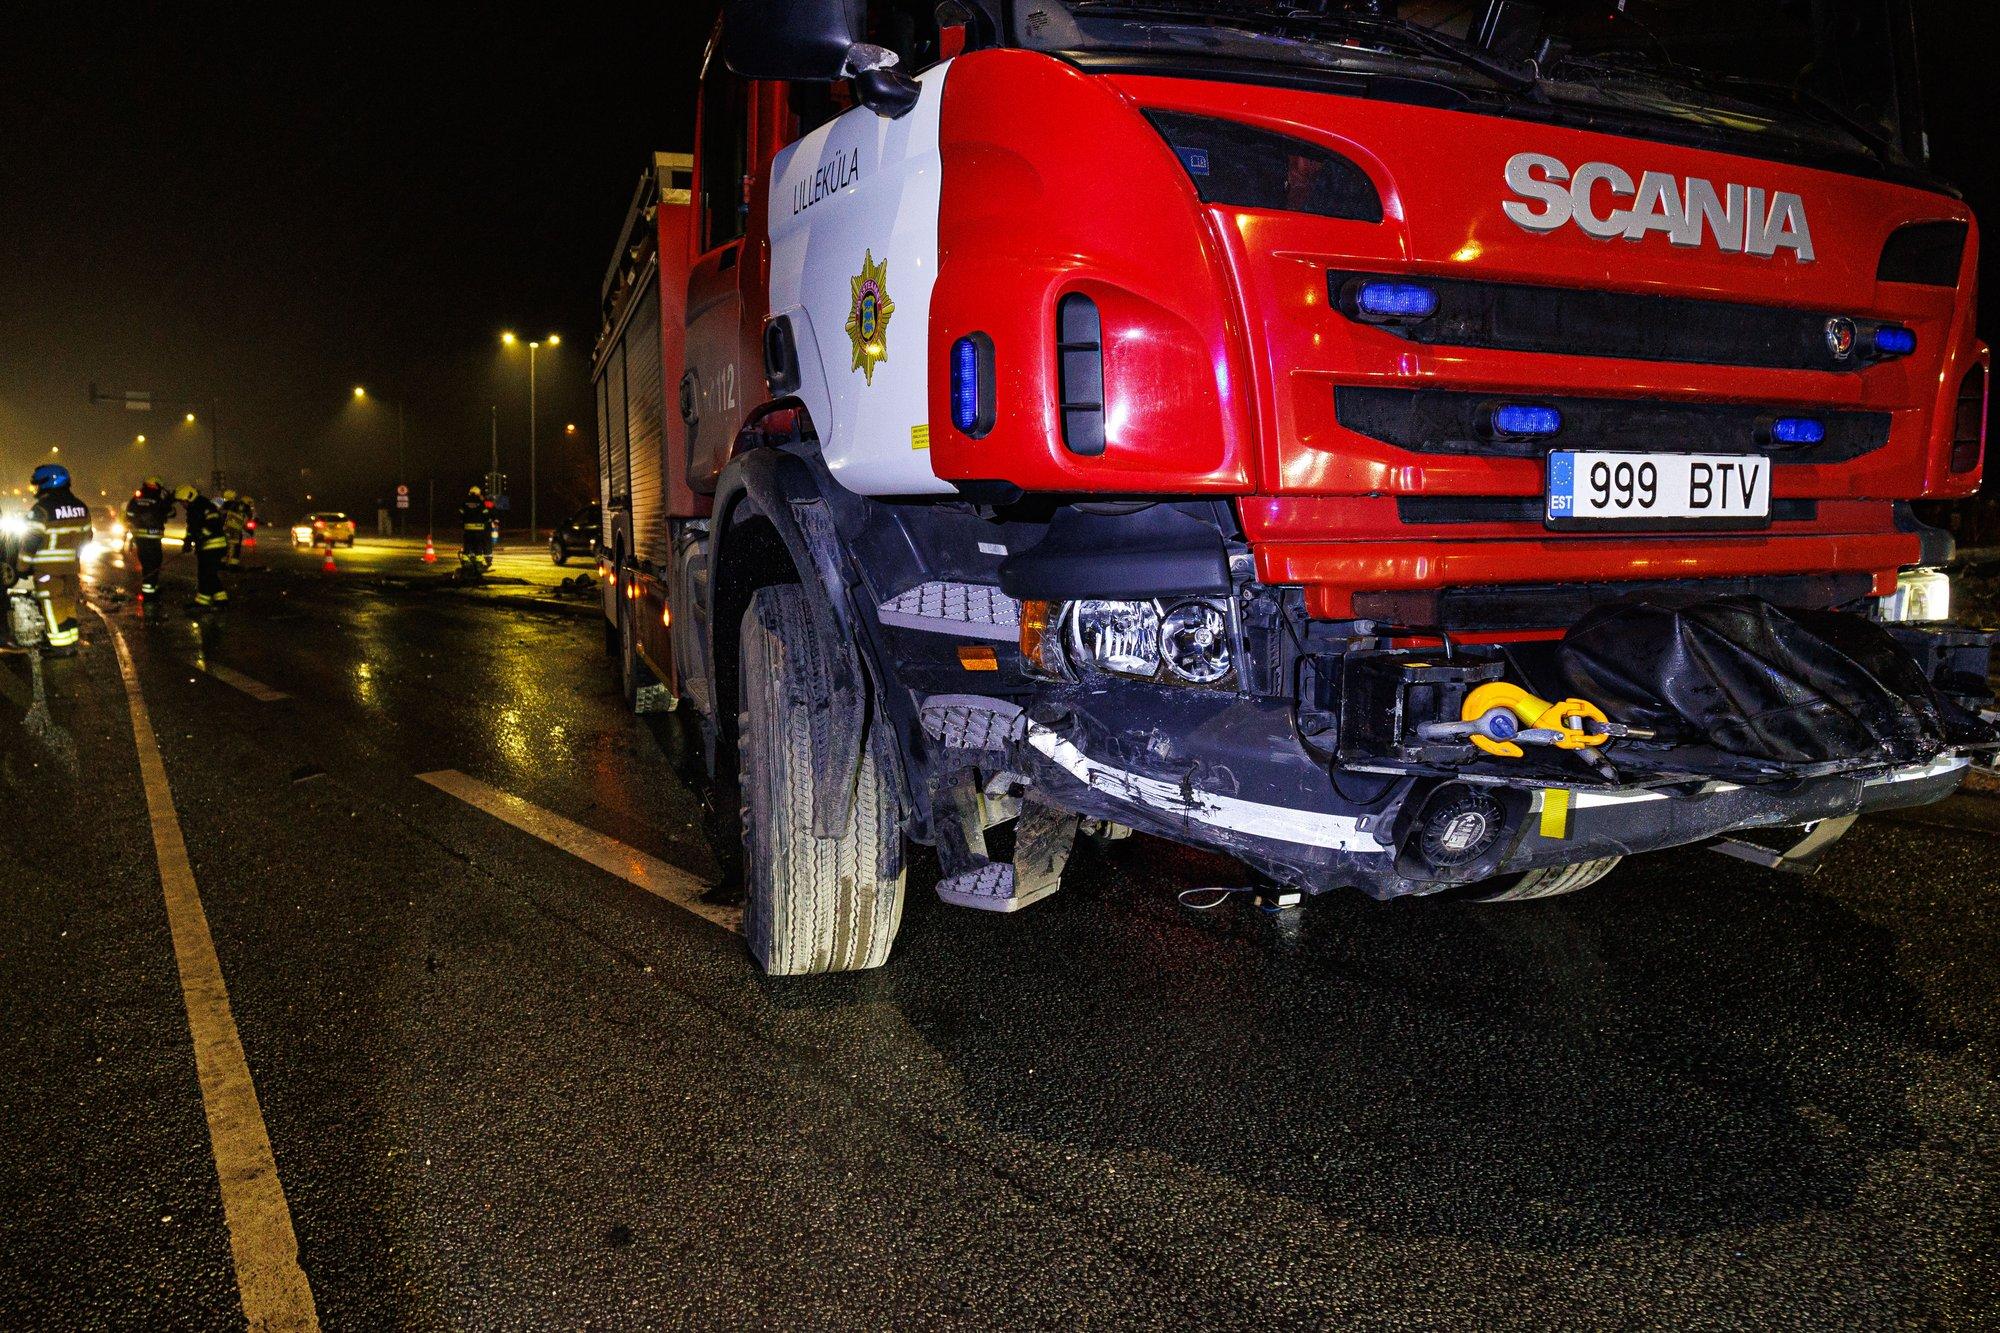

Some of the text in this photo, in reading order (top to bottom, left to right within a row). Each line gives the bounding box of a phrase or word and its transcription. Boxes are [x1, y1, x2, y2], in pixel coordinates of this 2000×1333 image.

[794, 147, 858, 215] LILLEKÜLA
[1502, 152, 1815, 262] SCANIA
[716, 363, 735, 412] 112
[1551, 495, 1572, 509] EST
[1590, 461, 1759, 509] 999 BTV
